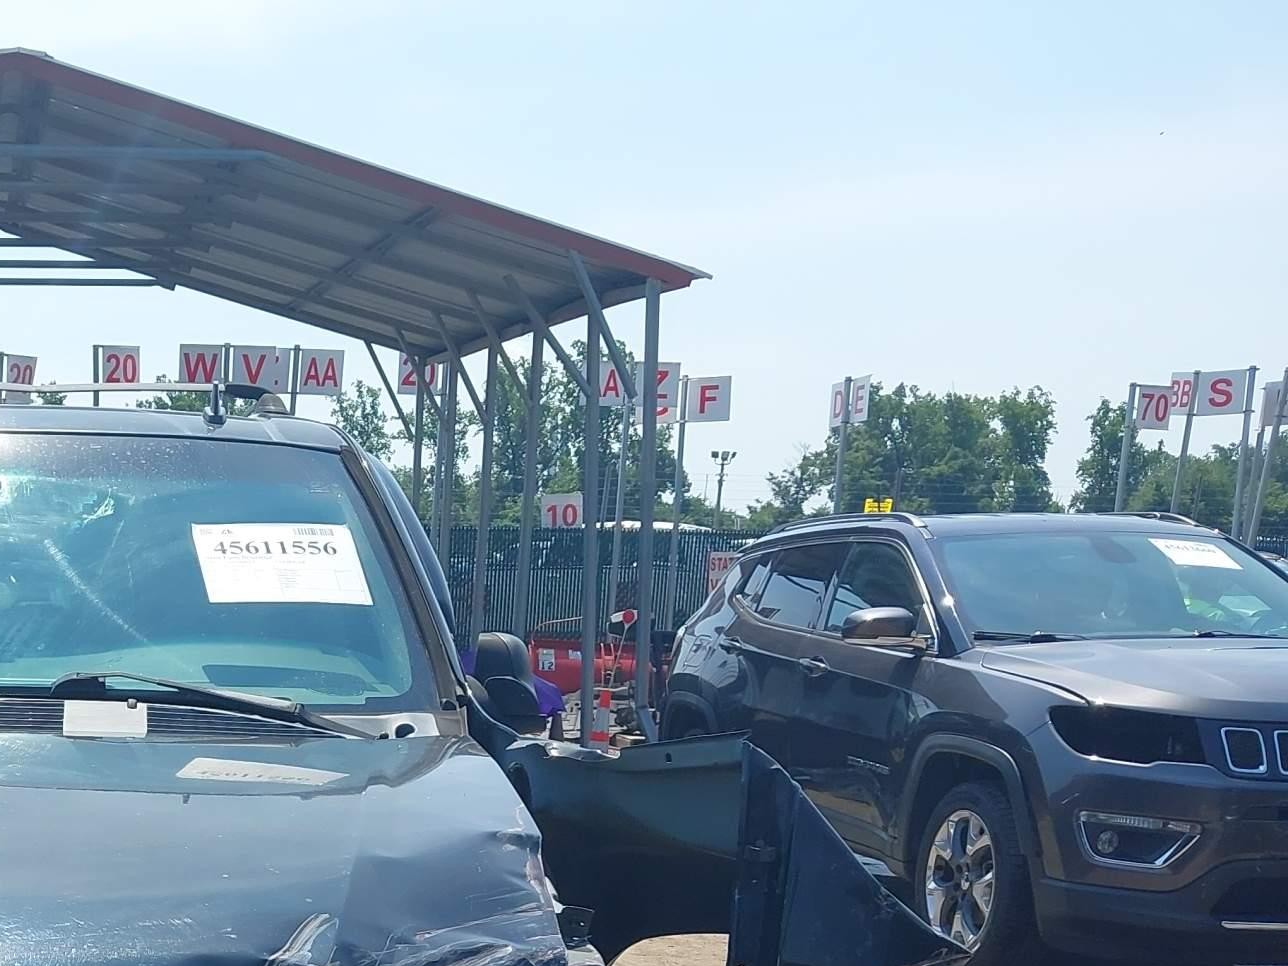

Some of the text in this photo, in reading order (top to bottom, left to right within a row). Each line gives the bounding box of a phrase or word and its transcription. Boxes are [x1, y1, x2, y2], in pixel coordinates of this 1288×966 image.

[10, 363, 33, 385] 20
[105, 353, 137, 383] 20
[183, 352, 219, 383] W
[242, 354, 267, 384] V
[303, 357, 338, 387] AA
[699, 384, 720, 414] F
[854, 383, 866, 415] E
[1142, 393, 1169, 422] 70
[1209, 378, 1233, 408] S
[547, 503, 578, 528] 10
[213, 540, 338, 556] 45611556
